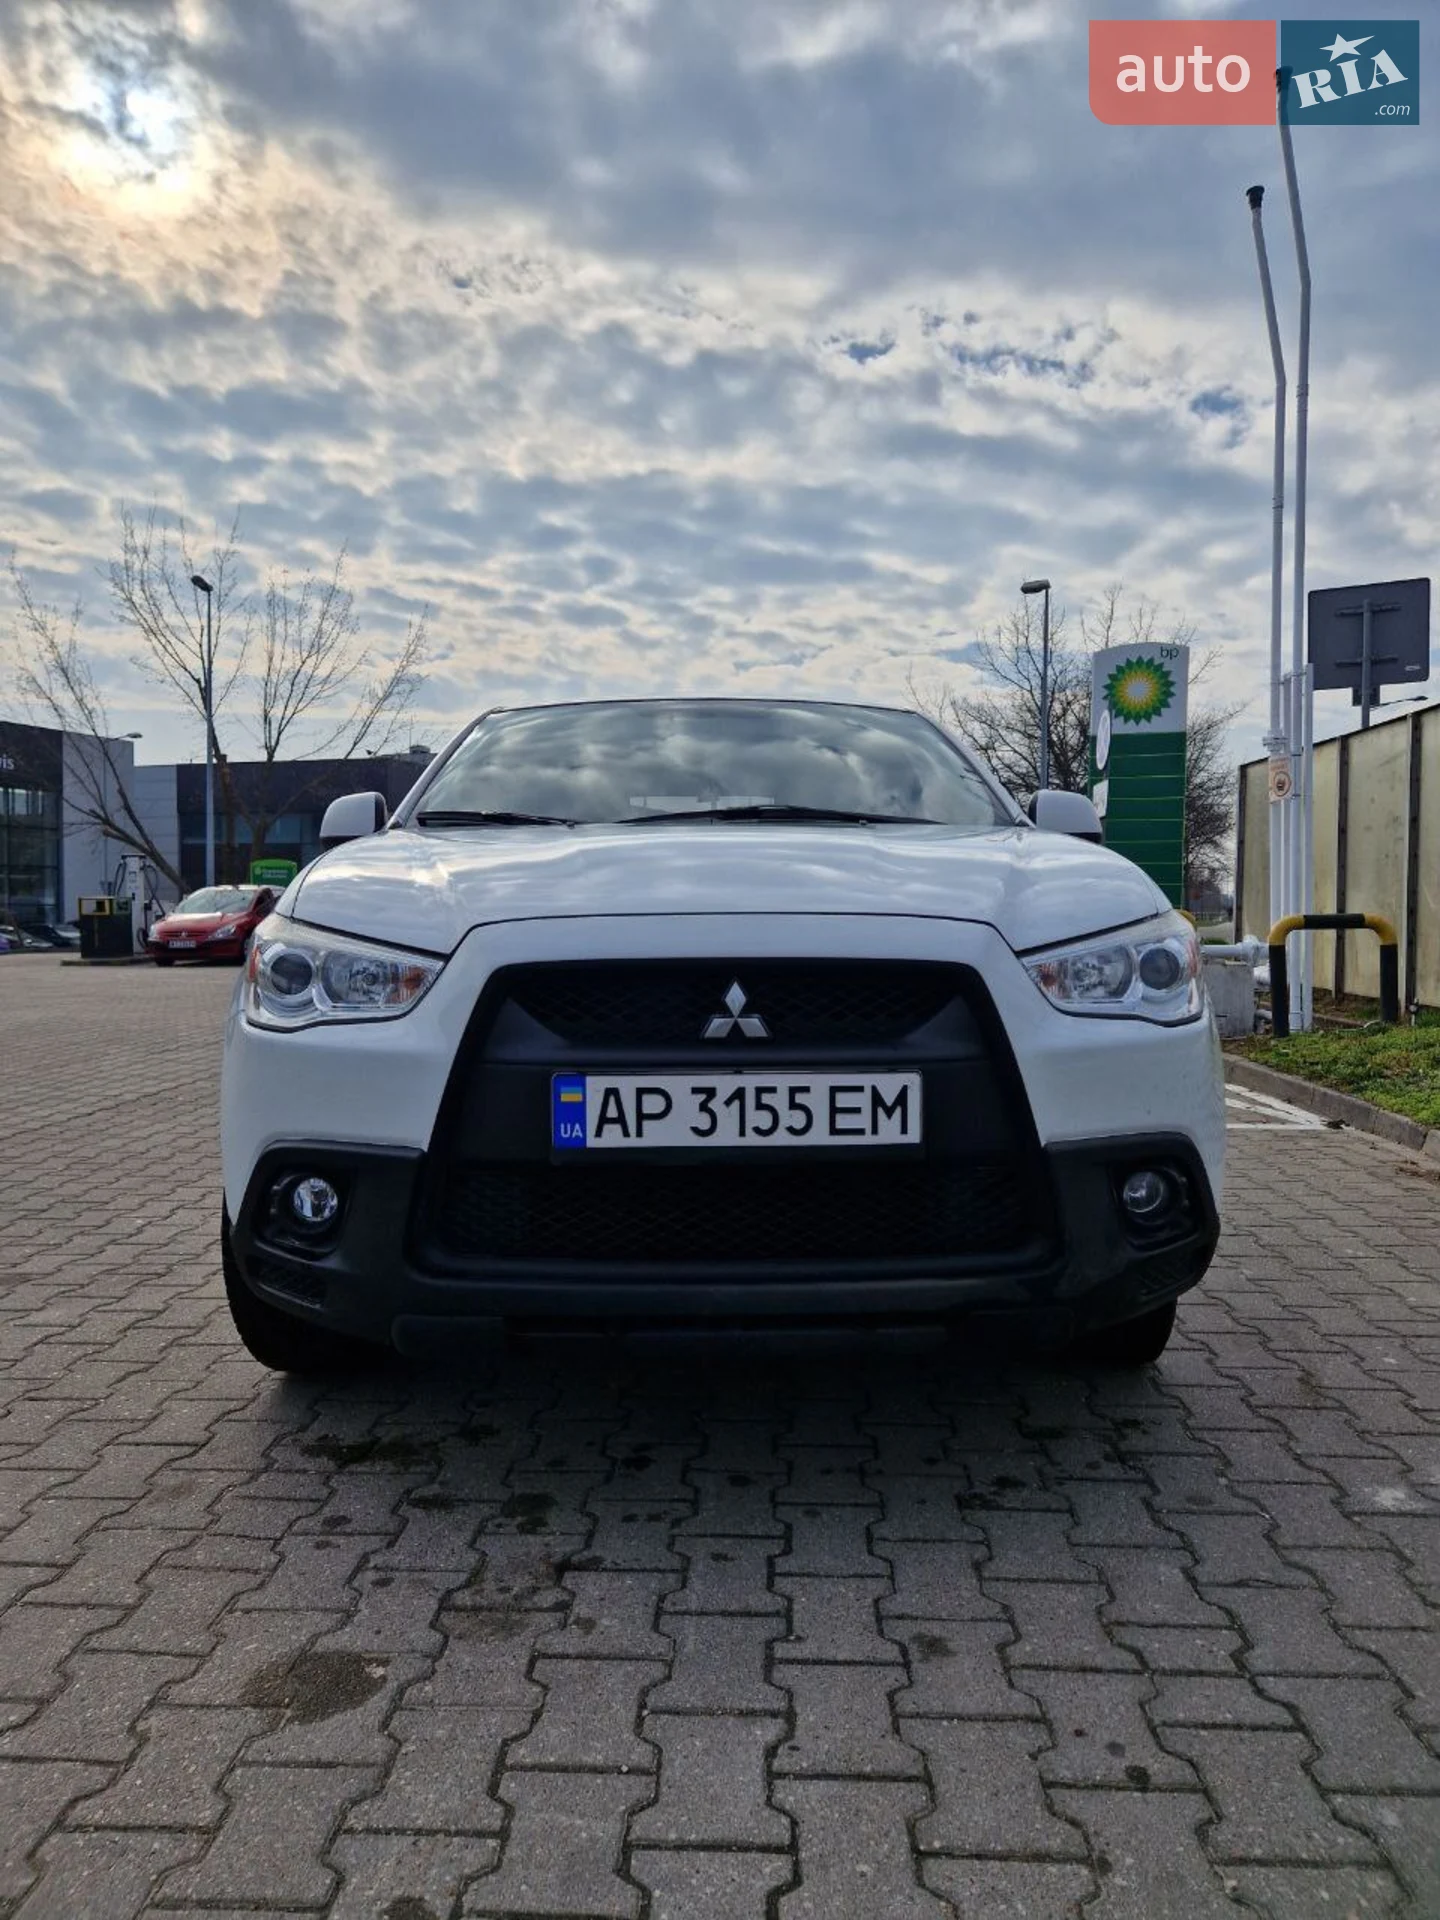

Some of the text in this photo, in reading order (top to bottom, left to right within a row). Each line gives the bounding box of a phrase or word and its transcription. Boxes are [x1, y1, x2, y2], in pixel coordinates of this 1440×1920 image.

[1160, 646, 1180, 660] bp
[594, 1084, 909, 1138] AP 3155 EM
[560, 1122, 583, 1138] UA
